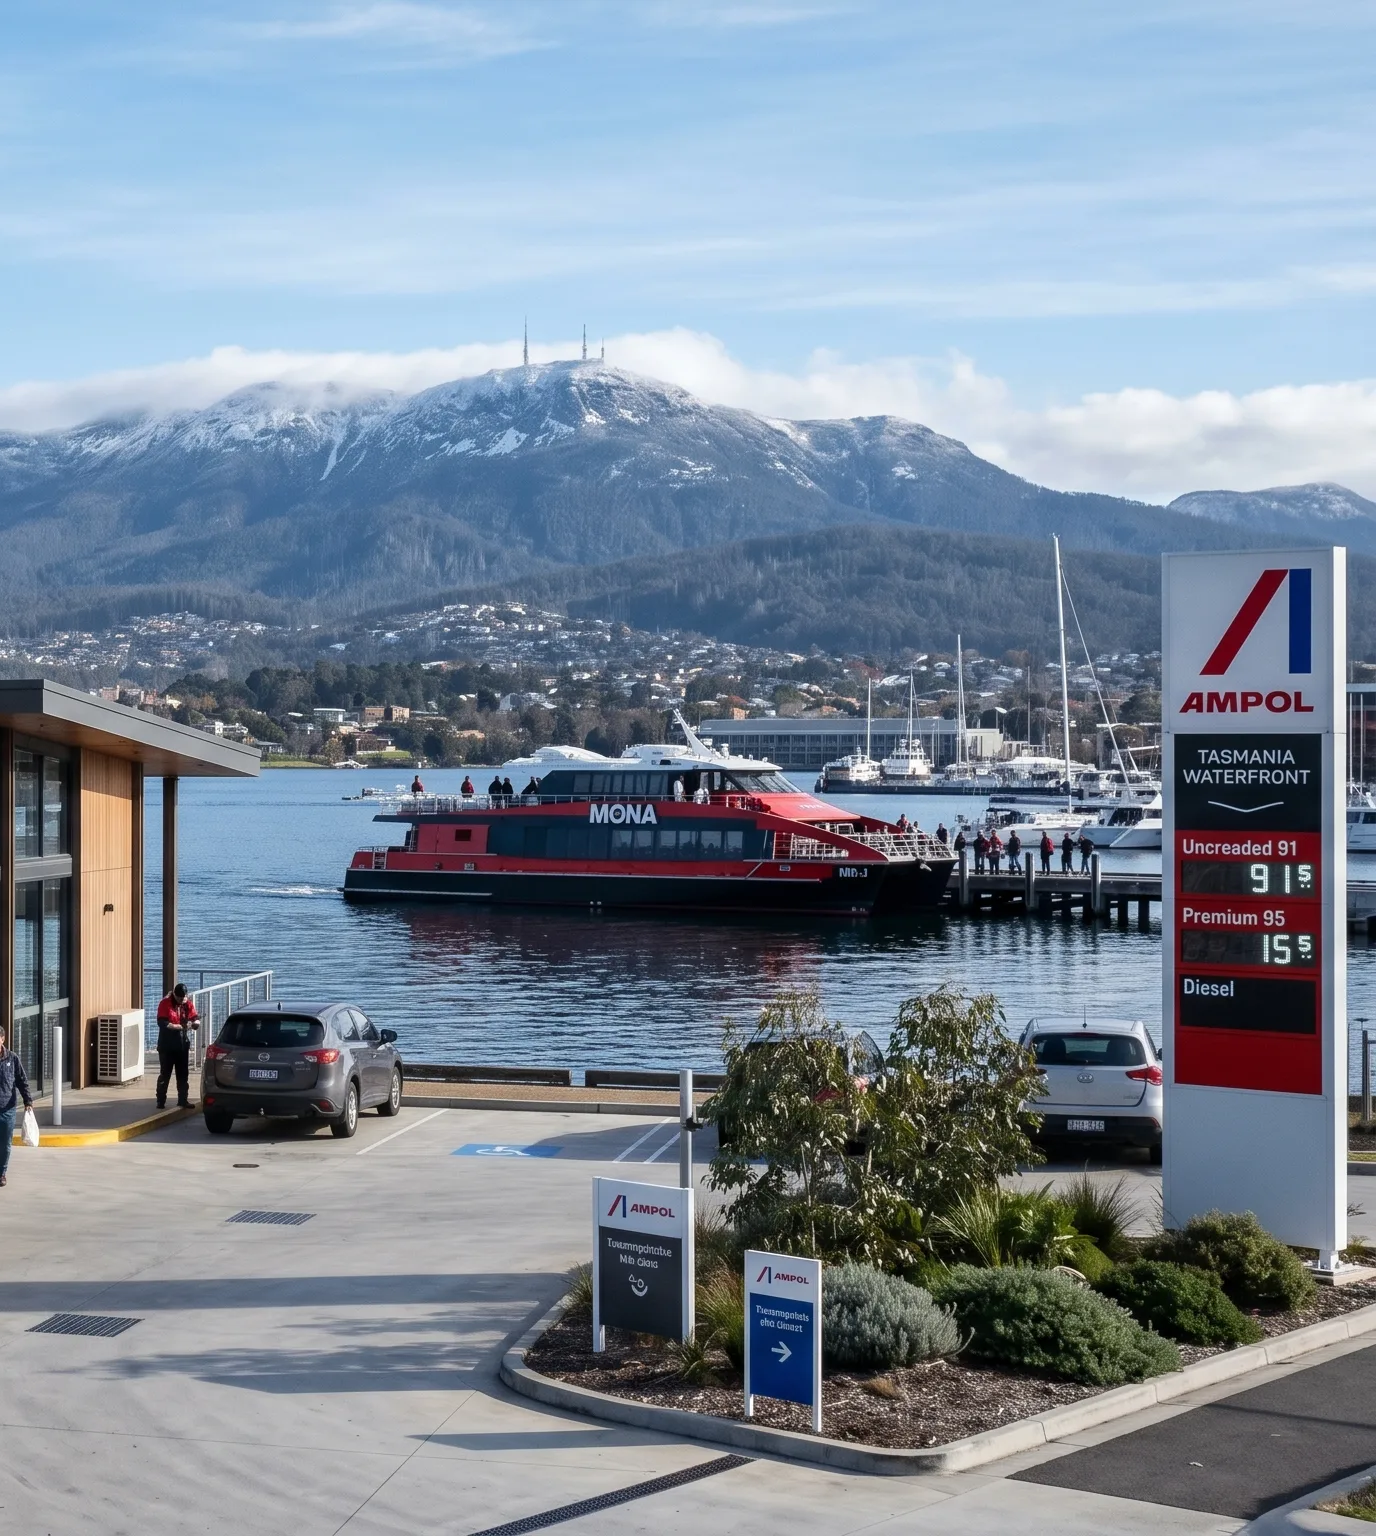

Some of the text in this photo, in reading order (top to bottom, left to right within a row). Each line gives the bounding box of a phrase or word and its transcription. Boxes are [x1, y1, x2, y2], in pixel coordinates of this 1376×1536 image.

[1178, 690, 1314, 713] AMPOL
[1197, 749, 1295, 764] TASMANIA
[1183, 769, 1311, 784] WATERFRONT
[589, 803, 657, 824] MONA
[1182, 838, 1297, 857] Uncreaded 91
[1182, 907, 1286, 927] Premium 95
[1183, 978, 1235, 997] Diesel
[630, 1203, 675, 1218] AMPOL
[774, 1272, 810, 1285] AMPOL
